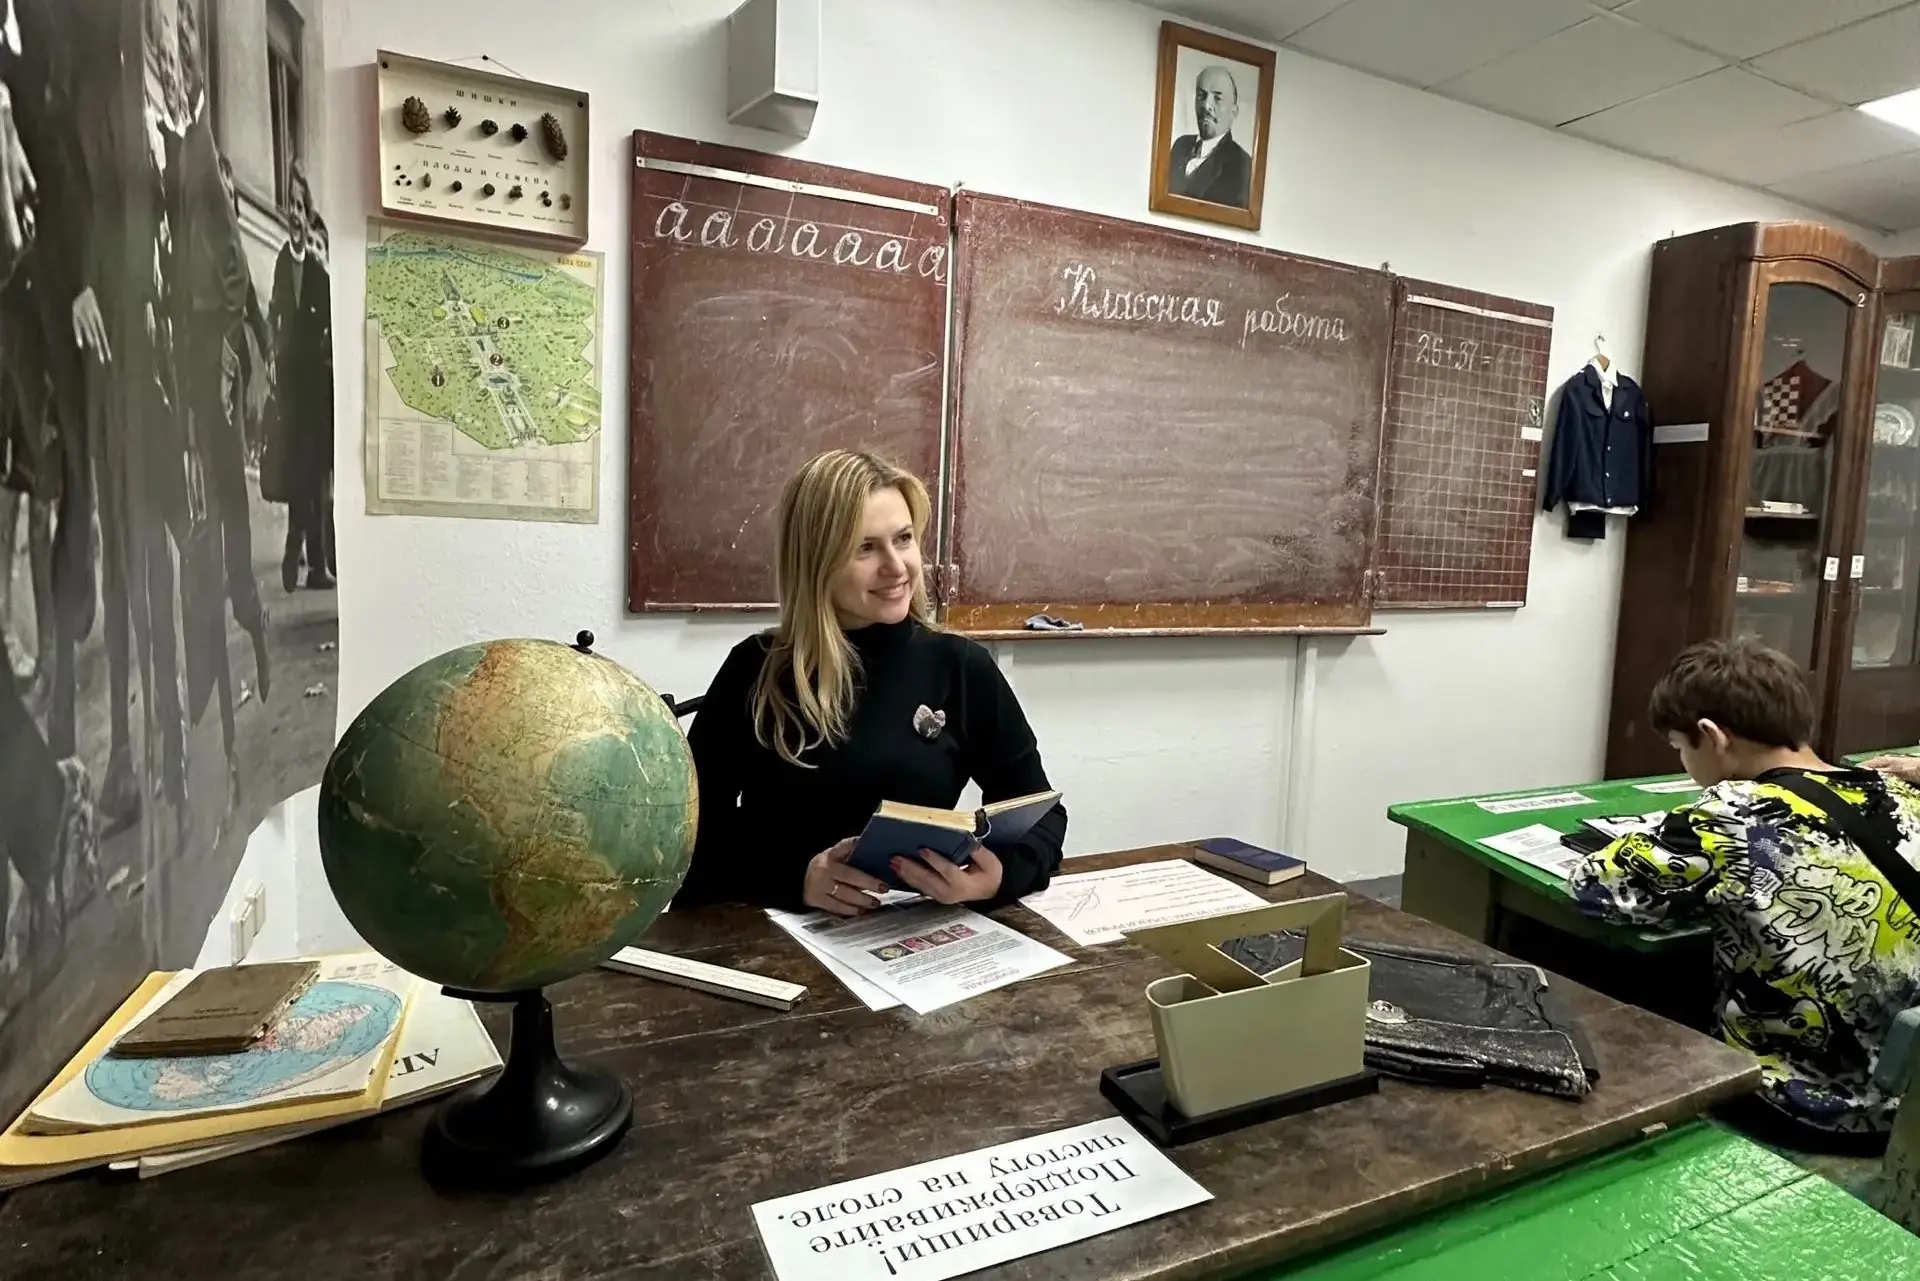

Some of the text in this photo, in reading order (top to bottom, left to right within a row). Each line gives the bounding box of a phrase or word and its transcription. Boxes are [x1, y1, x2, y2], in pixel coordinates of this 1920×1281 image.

[456, 89, 517, 108] ШИШКИ
[423, 160, 549, 186] ПЛОДЫ И СЕМЕНА
[1053, 263, 1350, 349] Классная работа
[1857, 292, 1866, 308] 2
[777, 1133, 1127, 1229] чистоту на столе.
[809, 1157, 1140, 1254] Поддерживайте
[878, 1191, 1123, 1277] Товарищи!
